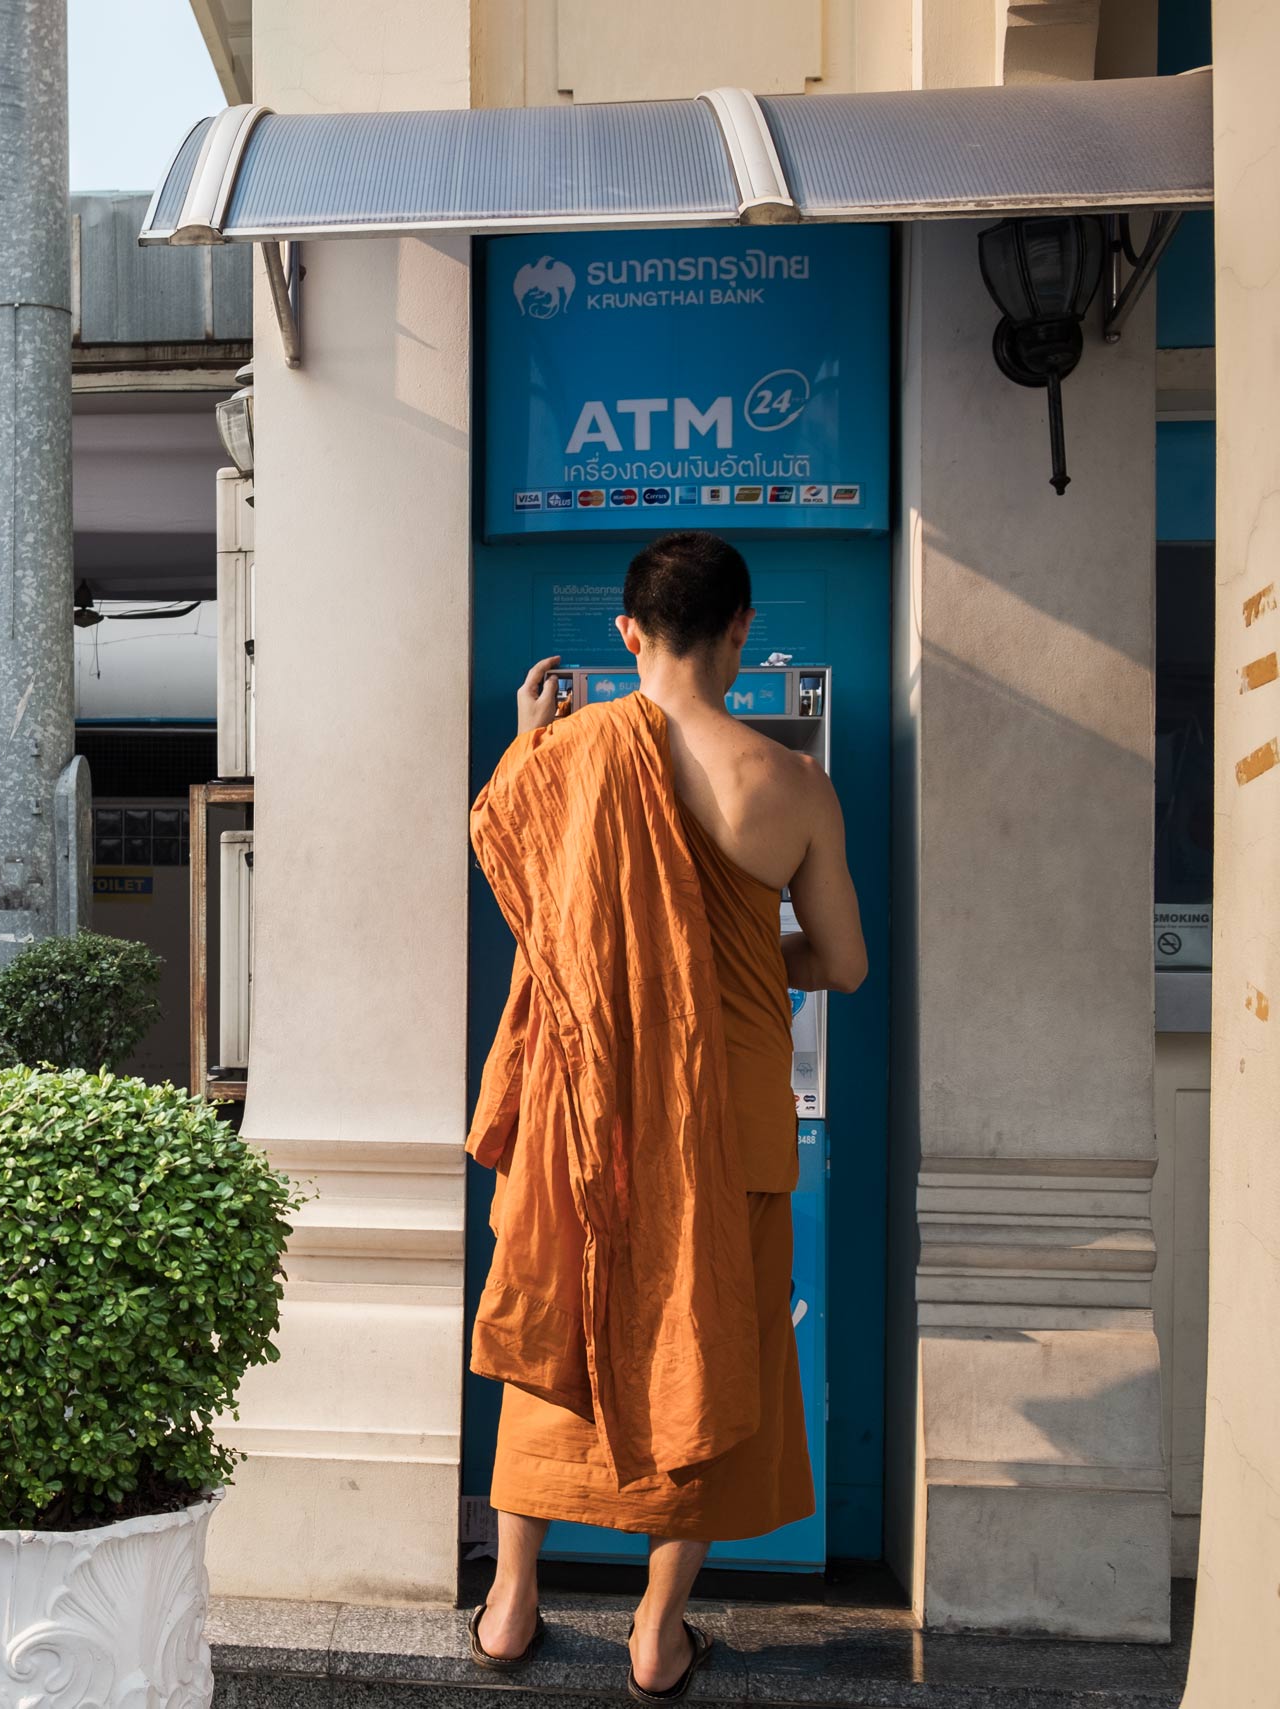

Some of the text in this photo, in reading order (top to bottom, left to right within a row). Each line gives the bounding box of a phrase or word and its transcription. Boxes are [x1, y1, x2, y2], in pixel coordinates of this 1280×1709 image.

[587, 249, 809, 287] ธนาคารกรุงไทย
[587, 288, 765, 310] KRUNGTHAI BANK
[565, 389, 792, 453] ATM 24
[564, 452, 811, 482] เครื่องถอนเงินอัตโนมัติ
[519, 494, 540, 503] VISA
[554, 498, 571, 506] PLUS
[1154, 913, 1210, 924] SMOKING
